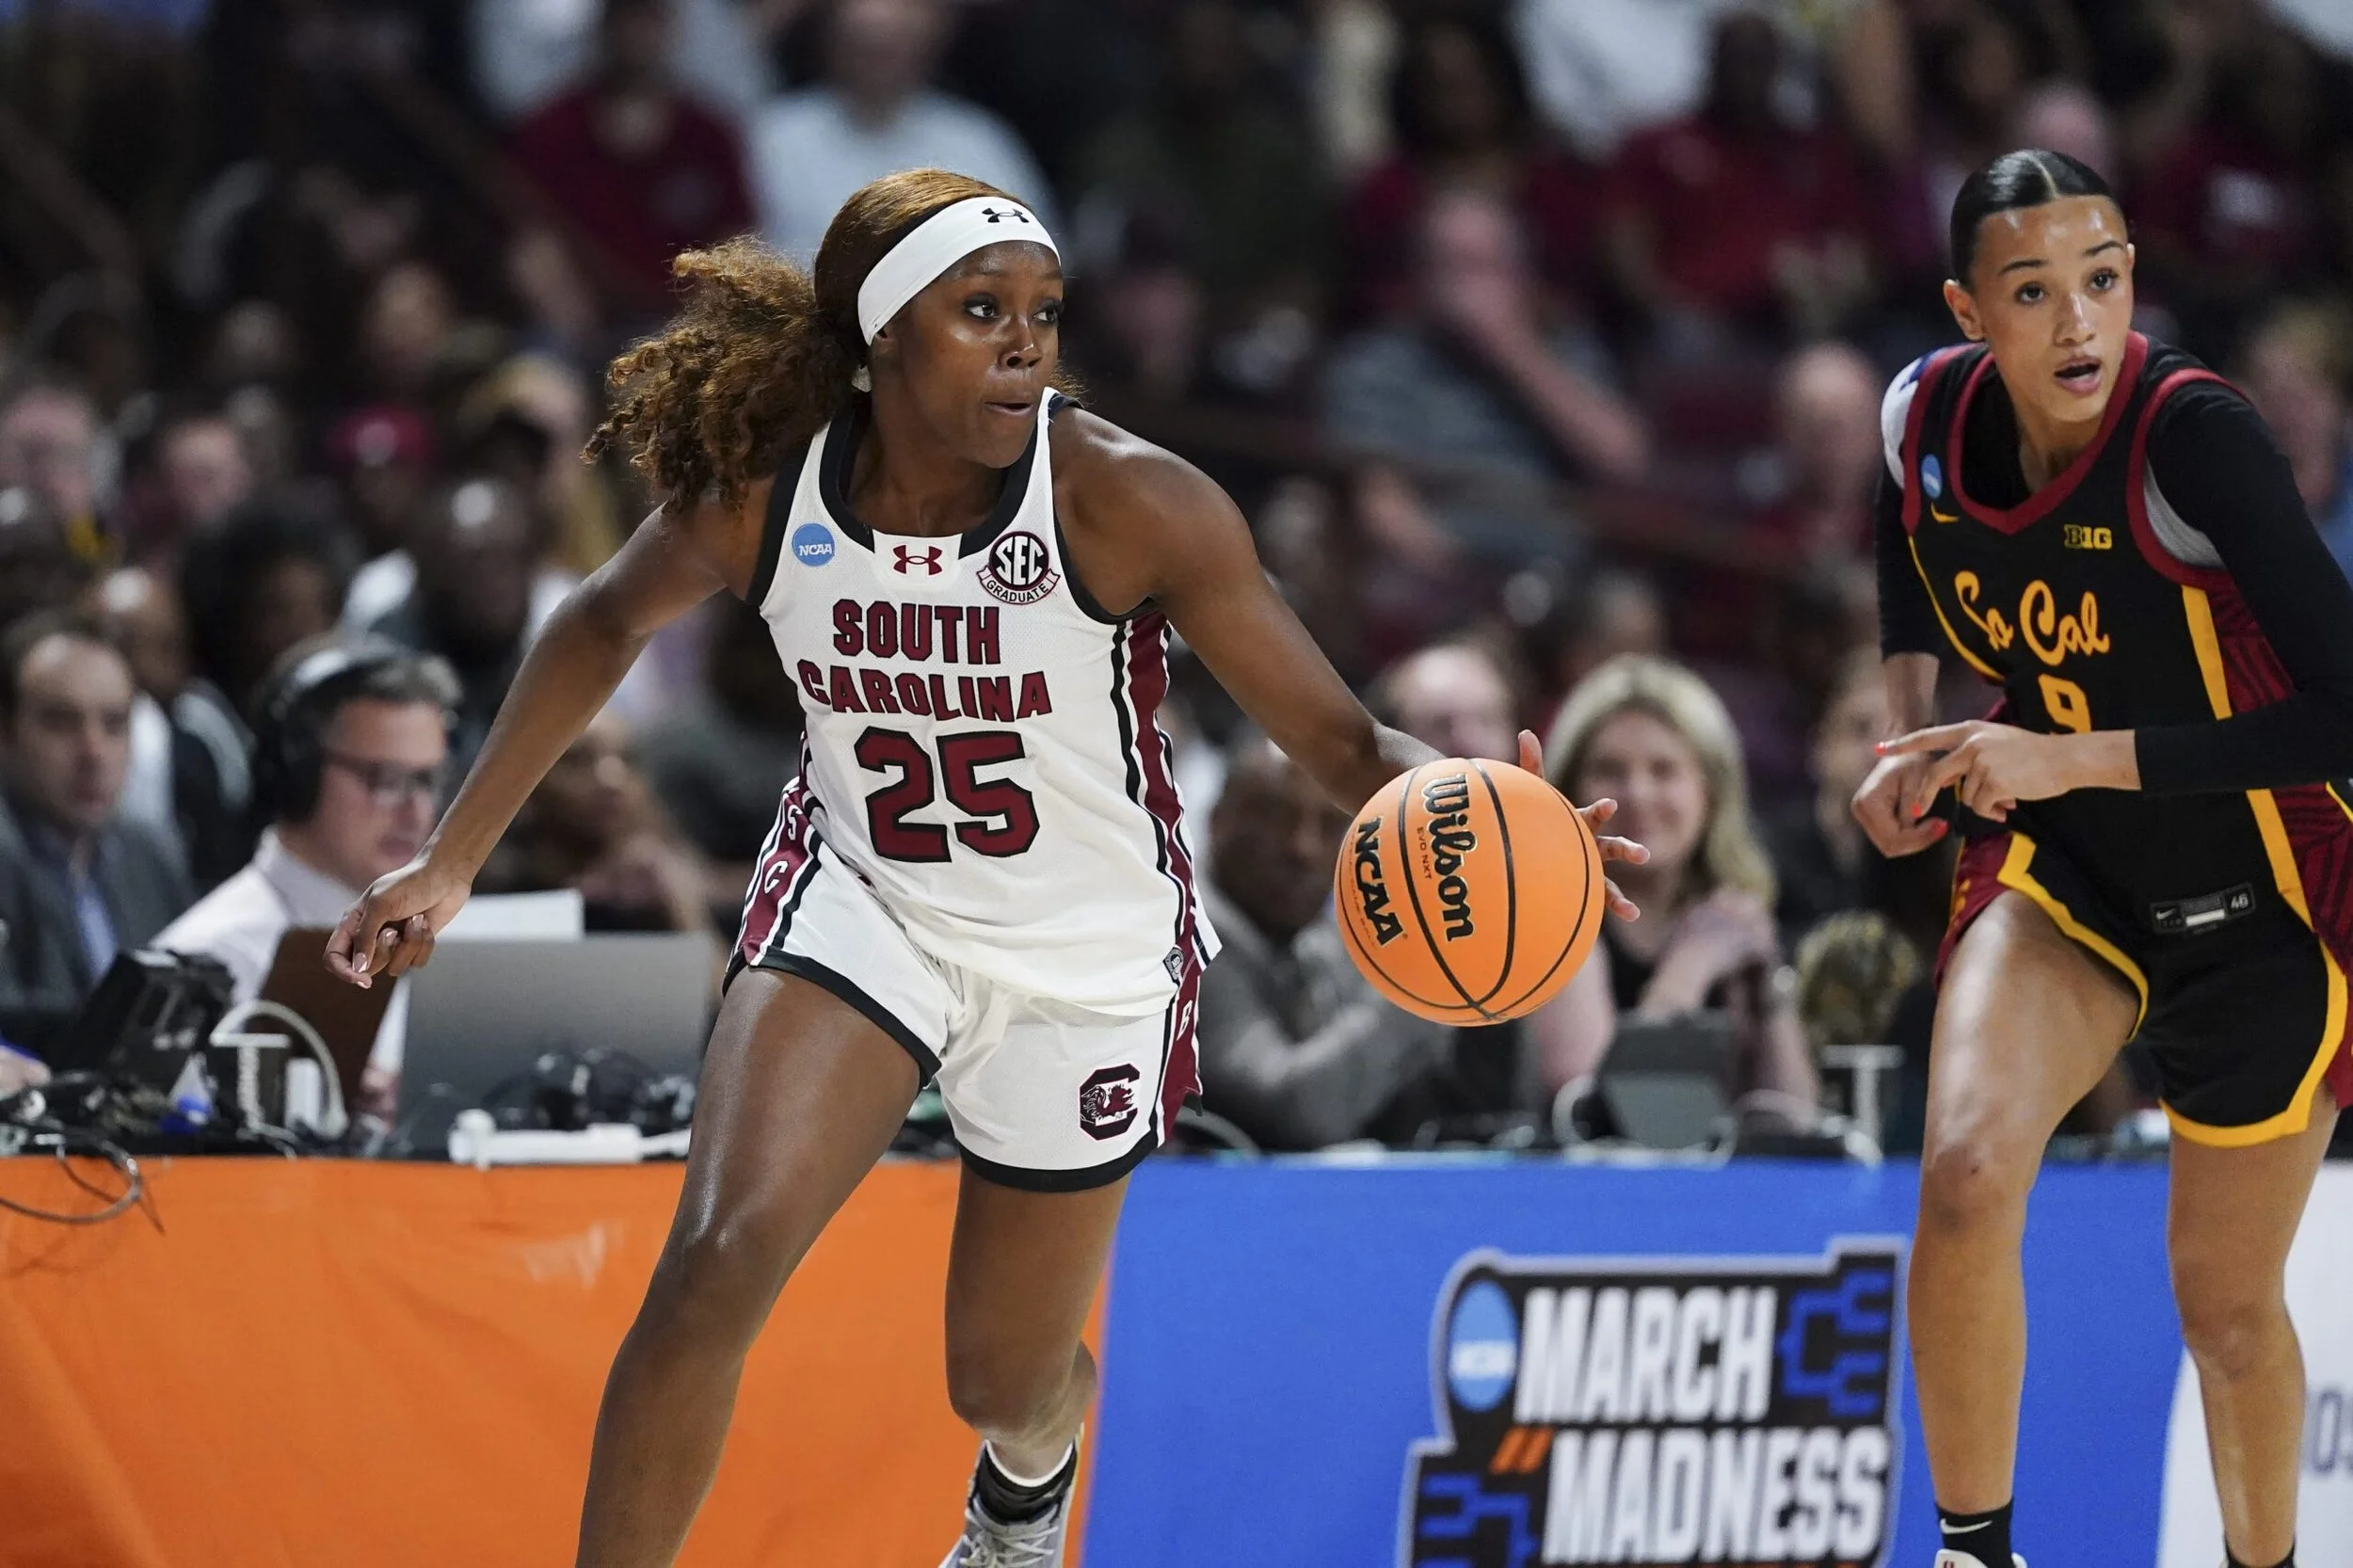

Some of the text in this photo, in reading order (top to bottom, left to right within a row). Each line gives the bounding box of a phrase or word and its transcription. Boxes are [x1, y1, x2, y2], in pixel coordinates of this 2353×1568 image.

[798, 544, 833, 557] NCAA
[995, 536, 1044, 585] SEC
[986, 580, 1049, 602] GRADUATE
[1954, 570, 2111, 666] So Cal
[833, 599, 1001, 664] SOUTH
[797, 659, 1053, 722] CAROLINA
[854, 726, 1041, 863] 25
[1355, 817, 1404, 946] NCAA
[1416, 826, 1433, 880] EVO NXT
[1421, 772, 1478, 942] Wilson
[1513, 1285, 1779, 1424] MARCH
[1541, 1423, 1891, 1566] MADNESS
